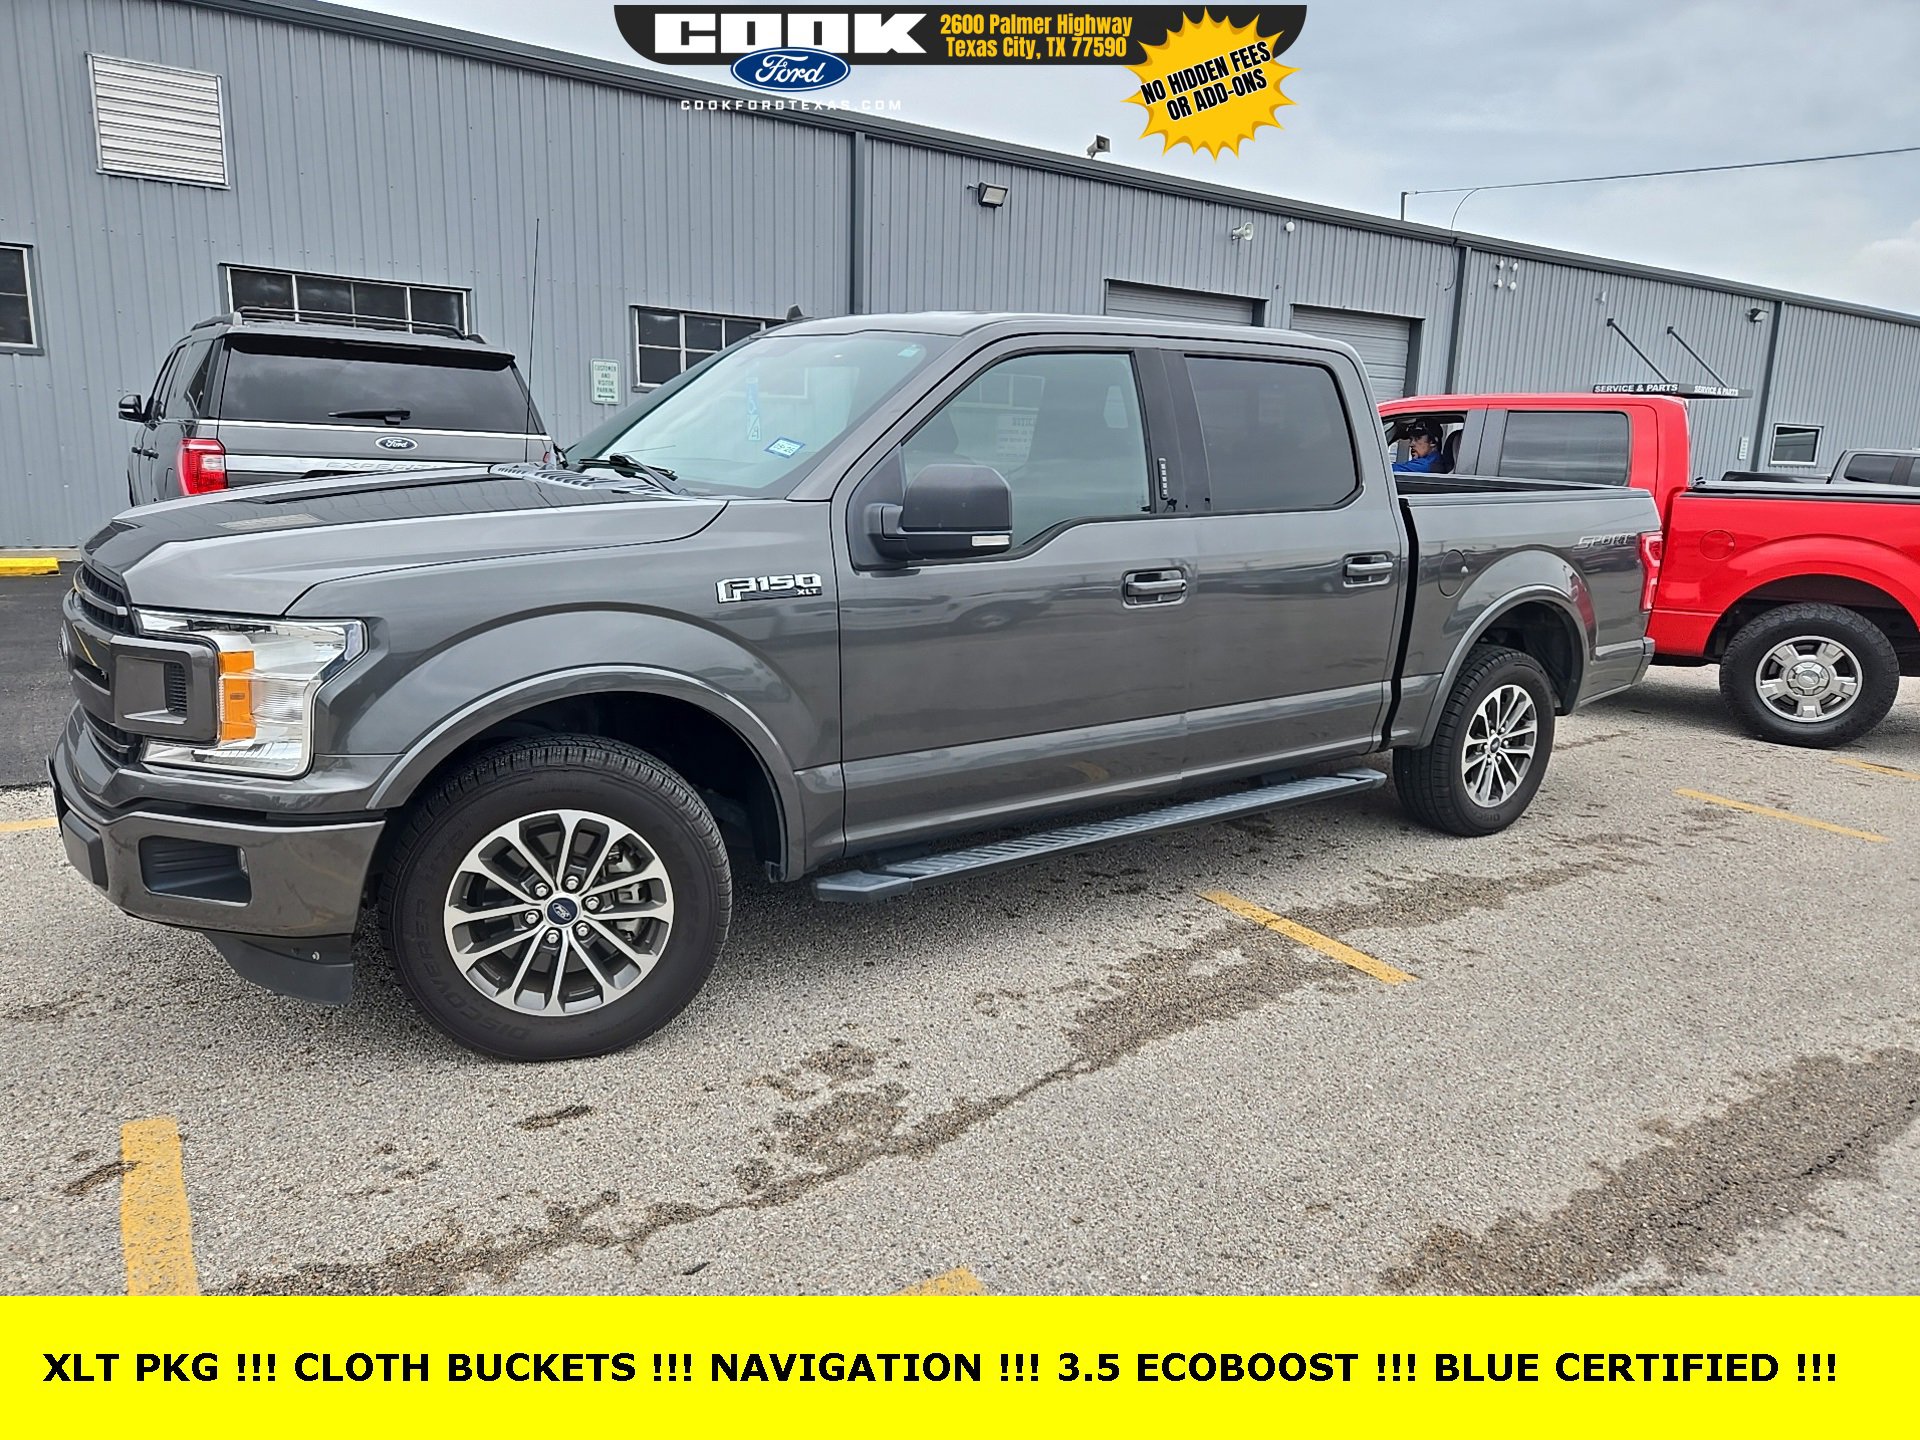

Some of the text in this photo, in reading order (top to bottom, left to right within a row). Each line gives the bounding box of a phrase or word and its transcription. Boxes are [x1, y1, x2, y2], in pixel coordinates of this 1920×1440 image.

[1594, 383, 1679, 393] SERVICE & PARTS
[1693, 385, 1717, 395] SERVICE
[1572, 533, 1637, 552] SPORT
[797, 588, 819, 596] XLT
